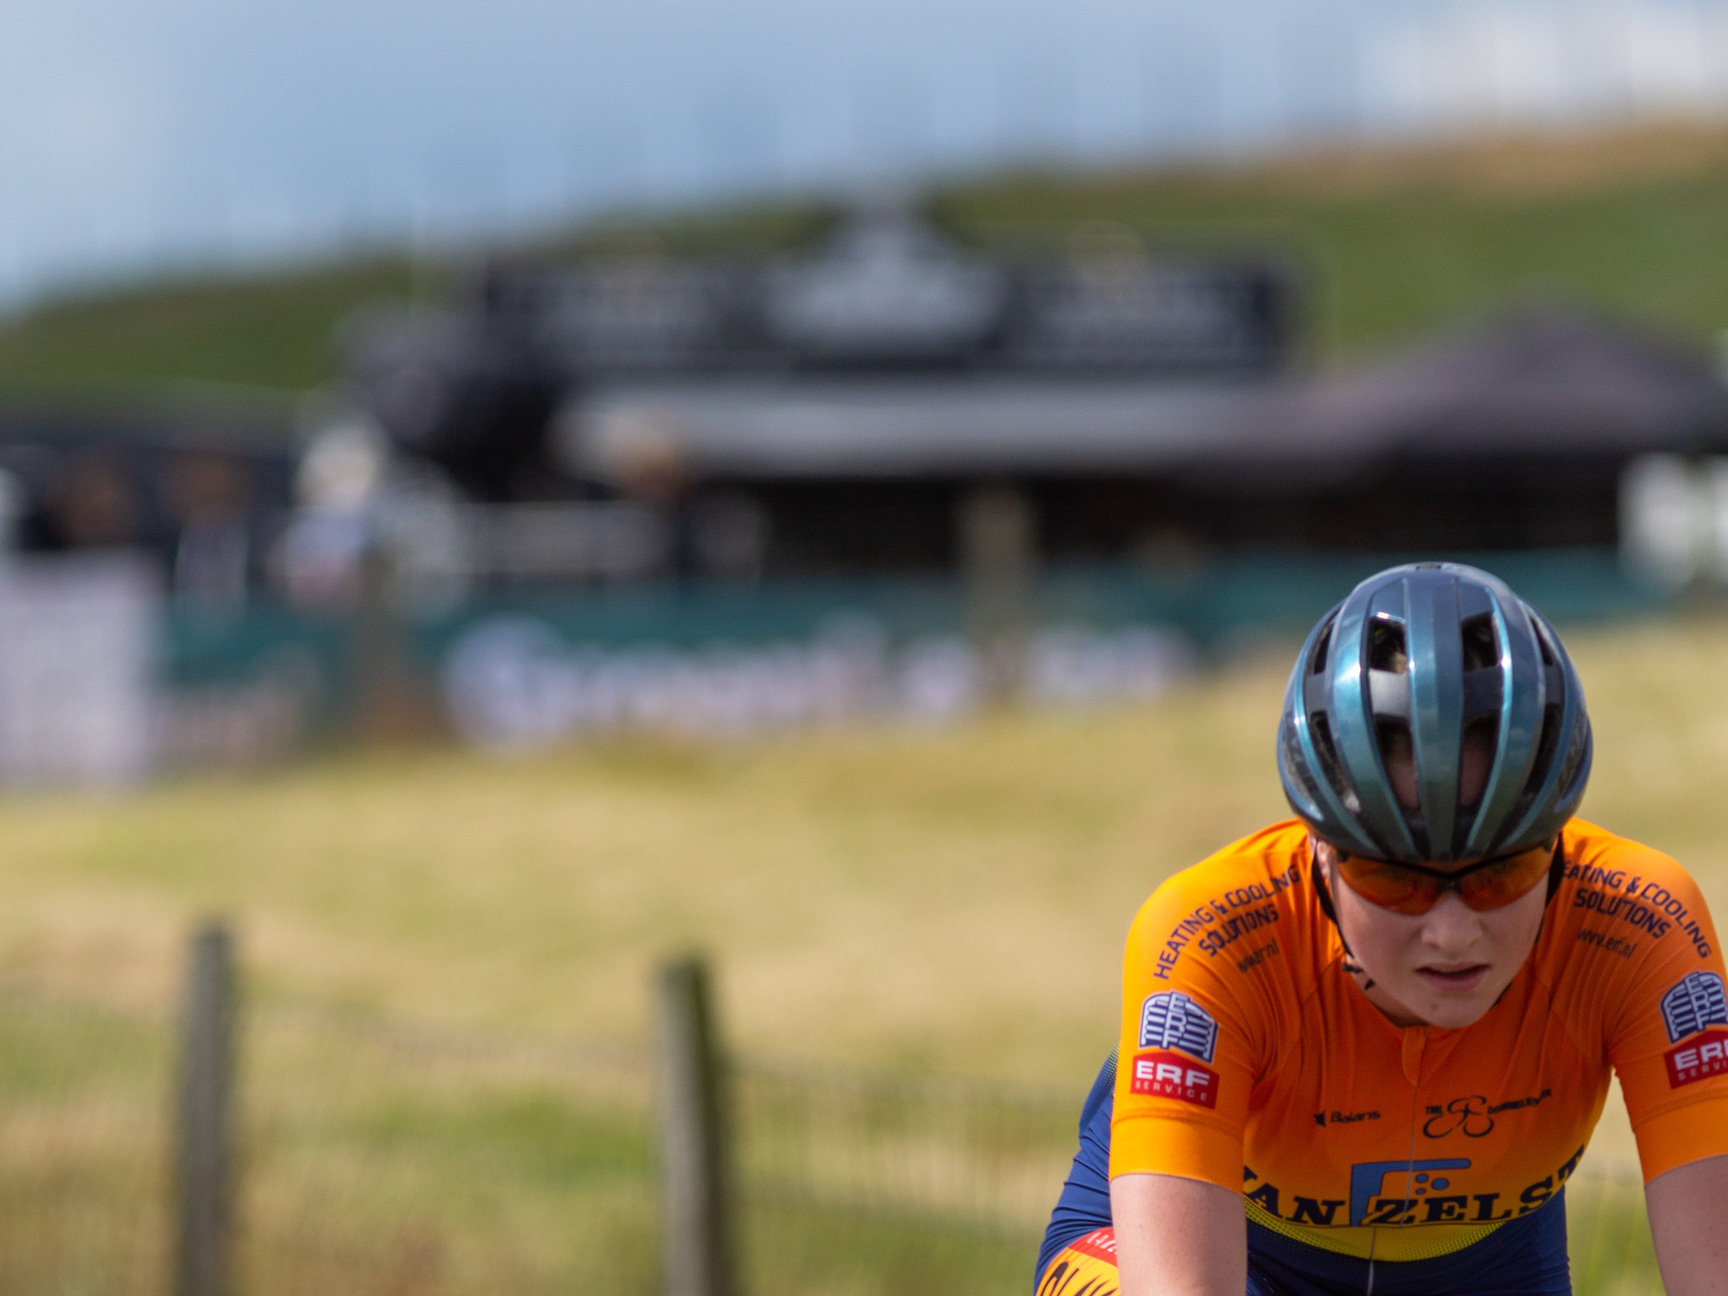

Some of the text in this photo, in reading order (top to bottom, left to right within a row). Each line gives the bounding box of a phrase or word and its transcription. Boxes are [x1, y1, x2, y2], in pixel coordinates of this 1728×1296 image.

[1154, 864, 1301, 980] HEATING & COOLING
[1198, 903, 1279, 957] SOLUTIONS
[1564, 861, 1712, 959] EATING & COOLING
[1573, 888, 1672, 939] SOLUTIONS
[1135, 1080, 1208, 1102] SERVICE
[1136, 1060, 1210, 1087] ERF
